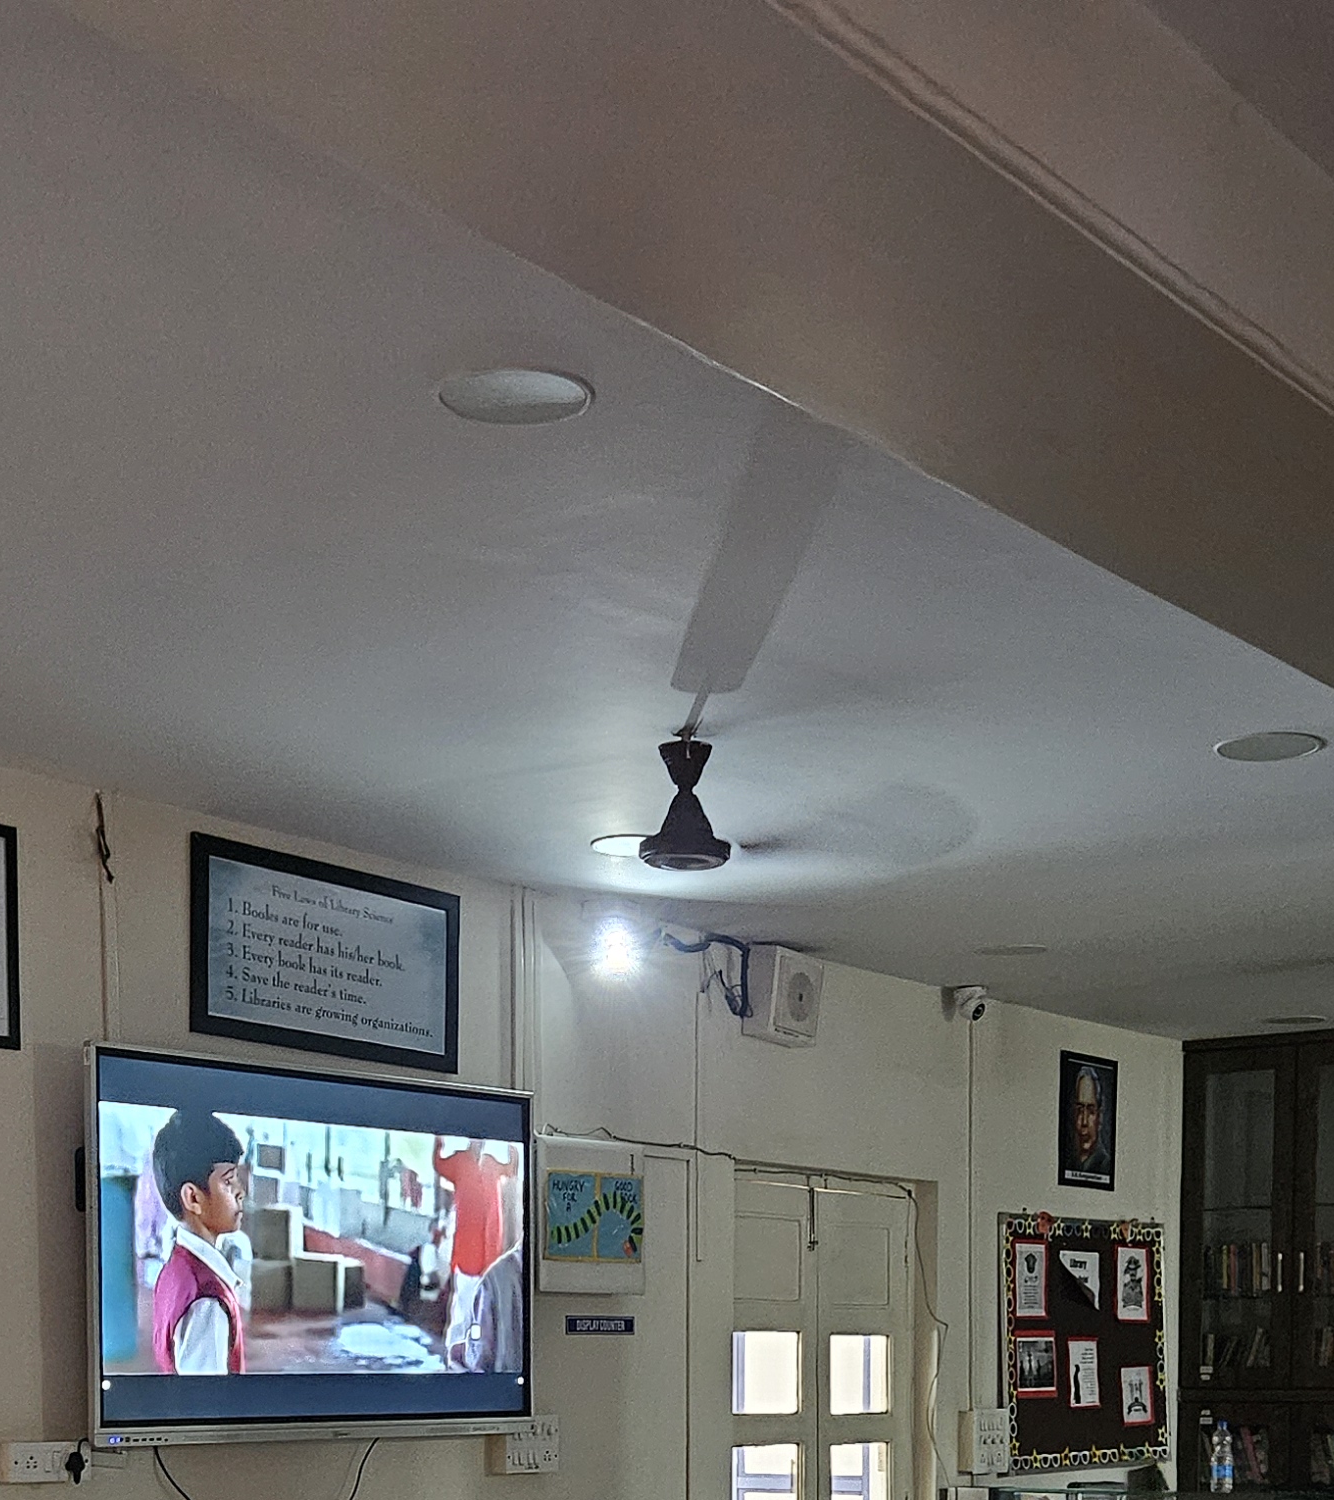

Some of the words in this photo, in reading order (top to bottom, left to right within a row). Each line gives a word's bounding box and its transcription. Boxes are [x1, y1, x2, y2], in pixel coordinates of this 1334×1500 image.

[228, 898, 239, 913] 1.
[242, 901, 279, 923] Books
[282, 916, 299, 928] are
[303, 912, 320, 931] for
[323, 924, 343, 937] use.
[319, 895, 328, 909] of
[329, 899, 361, 918] Library
[226, 919, 239, 936] 2.
[243, 923, 275, 947] Every
[278, 933, 313, 952] reader
[316, 936, 335, 957] has
[337, 941, 375, 965] his/her
[377, 949, 405, 972] book.
[227, 942, 239, 958] 3.
[242, 945, 275, 969] Every
[278, 950, 306, 972] book
[308, 956, 328, 975] has
[330, 965, 344, 979] its
[346, 968, 383, 987] reader.
[226, 964, 238, 979] 4.
[242, 966, 269, 986] Save
[272, 970, 290, 989] the
[293, 977, 336, 999] reader's
[339, 988, 367, 1005] time.
[225, 985, 238, 1002] 5.
[241, 988, 291, 1012] Libraries
[294, 1004, 313, 1016] are
[315, 1006, 359, 1028] growing
[360, 1014, 434, 1039] organizations.
[552, 1180, 586, 1193] HUNGRY
[562, 1191, 578, 1202] FOR
[614, 1180, 634, 1193] GOOD
